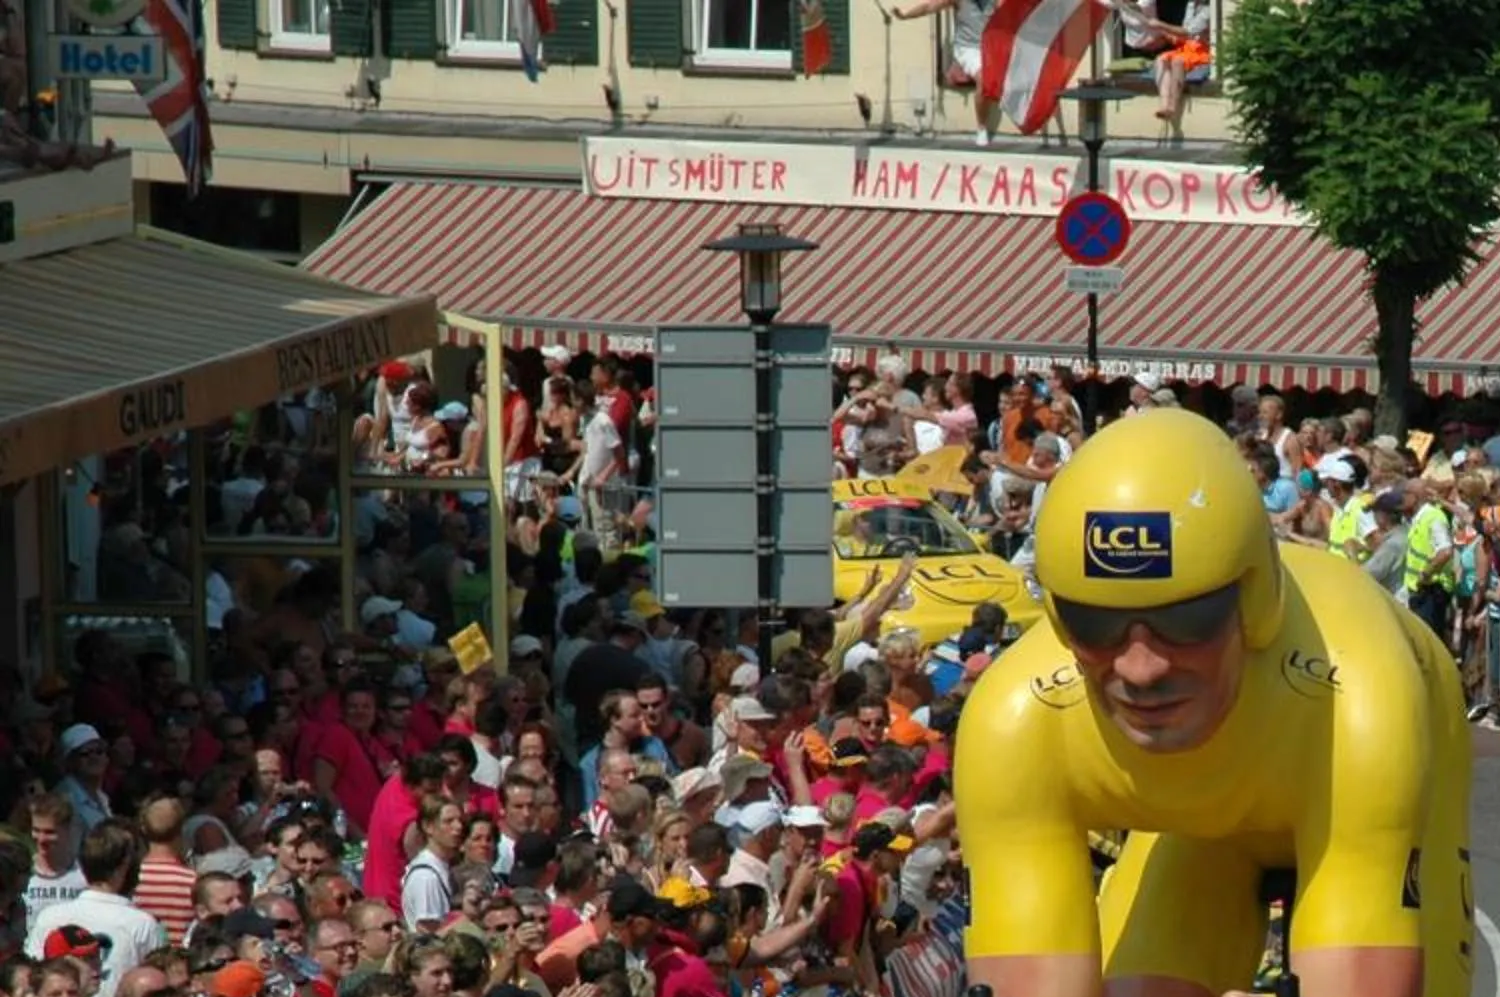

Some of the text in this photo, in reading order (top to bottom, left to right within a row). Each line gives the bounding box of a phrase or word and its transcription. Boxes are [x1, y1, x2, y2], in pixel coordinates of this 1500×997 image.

[60, 43, 153, 74] Hotel
[119, 314, 392, 437] GAUDI RESTAURANT
[849, 480, 897, 496] LCL
[1093, 527, 1161, 549] LCL
[916, 563, 1005, 581] LCL
[1289, 649, 1342, 685] LCL
